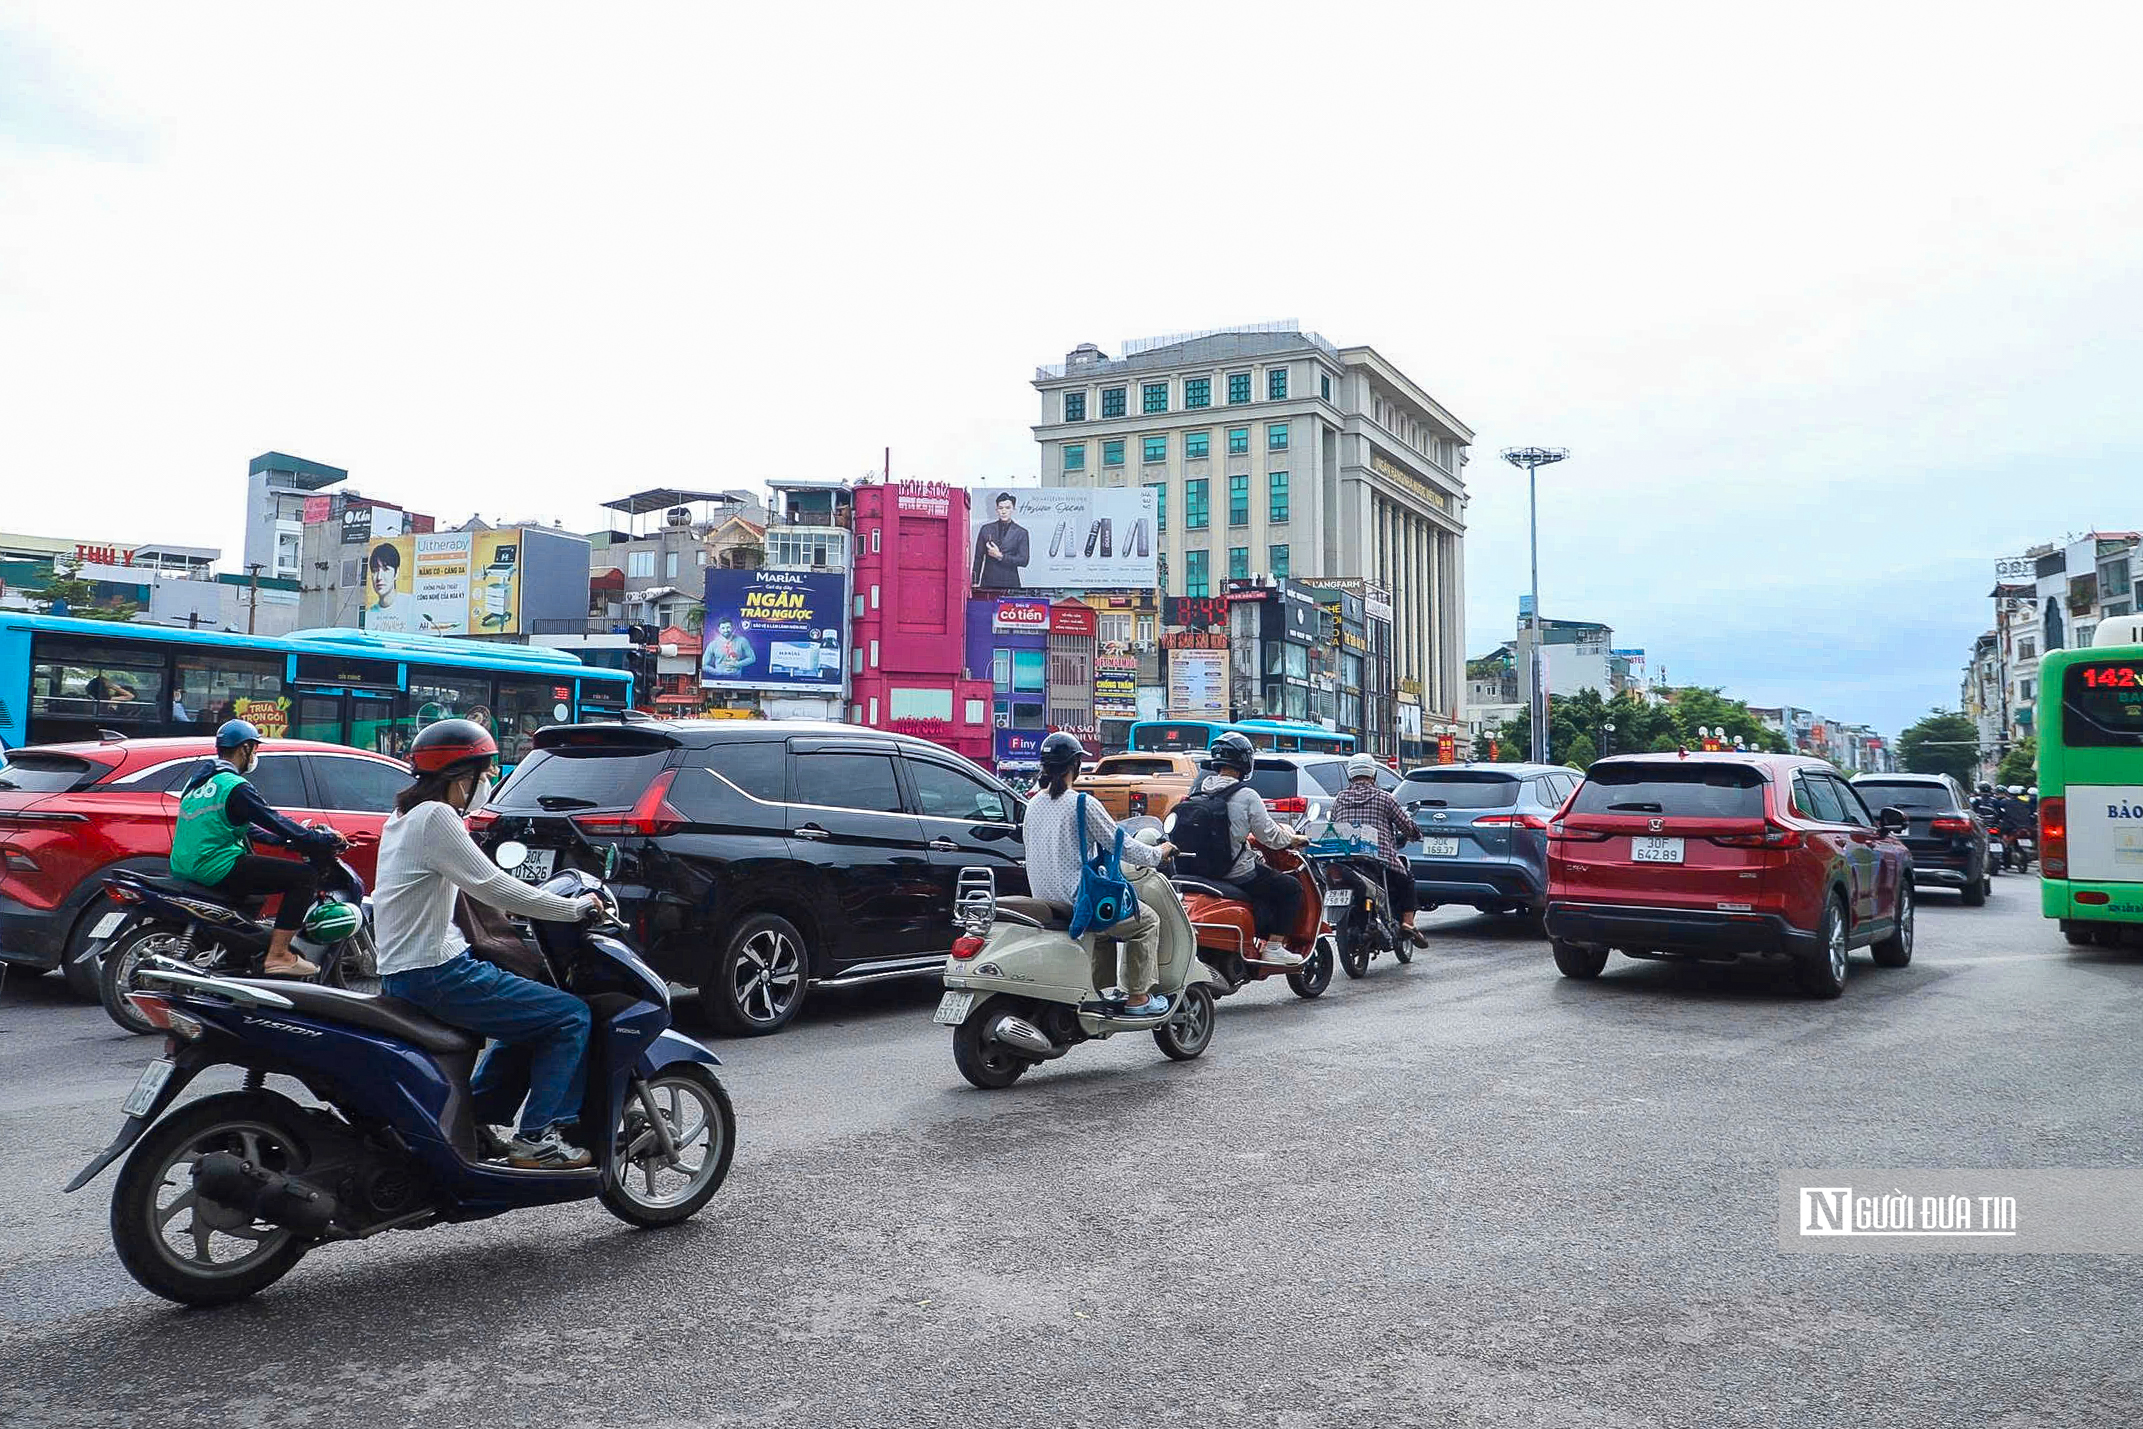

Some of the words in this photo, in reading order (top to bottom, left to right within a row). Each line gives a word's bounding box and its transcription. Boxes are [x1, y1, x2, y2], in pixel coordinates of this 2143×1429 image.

[418, 538, 468, 552] Ultherapy
[75, 543, 115, 564] THÚ
[122, 549, 136, 566] Y
[746, 591, 805, 608] NGĂN
[740, 607, 770, 618] TRÀO
[771, 608, 814, 622] NGƯỢC
[1000, 608, 1017, 620] có
[1018, 608, 1042, 621] tiền
[2083, 668, 2135, 687] 142
[250, 703, 273, 712] TRƯA
[241, 713, 266, 724] TRỌN
[267, 712, 284, 721] GÓI
[1057, 723, 1076, 733] YẾN
[1077, 724, 1094, 733] SÀO
[1647, 838, 1669, 849] 30F
[1637, 849, 1678, 861] 642.89
[243, 1015, 323, 1037] VISION
